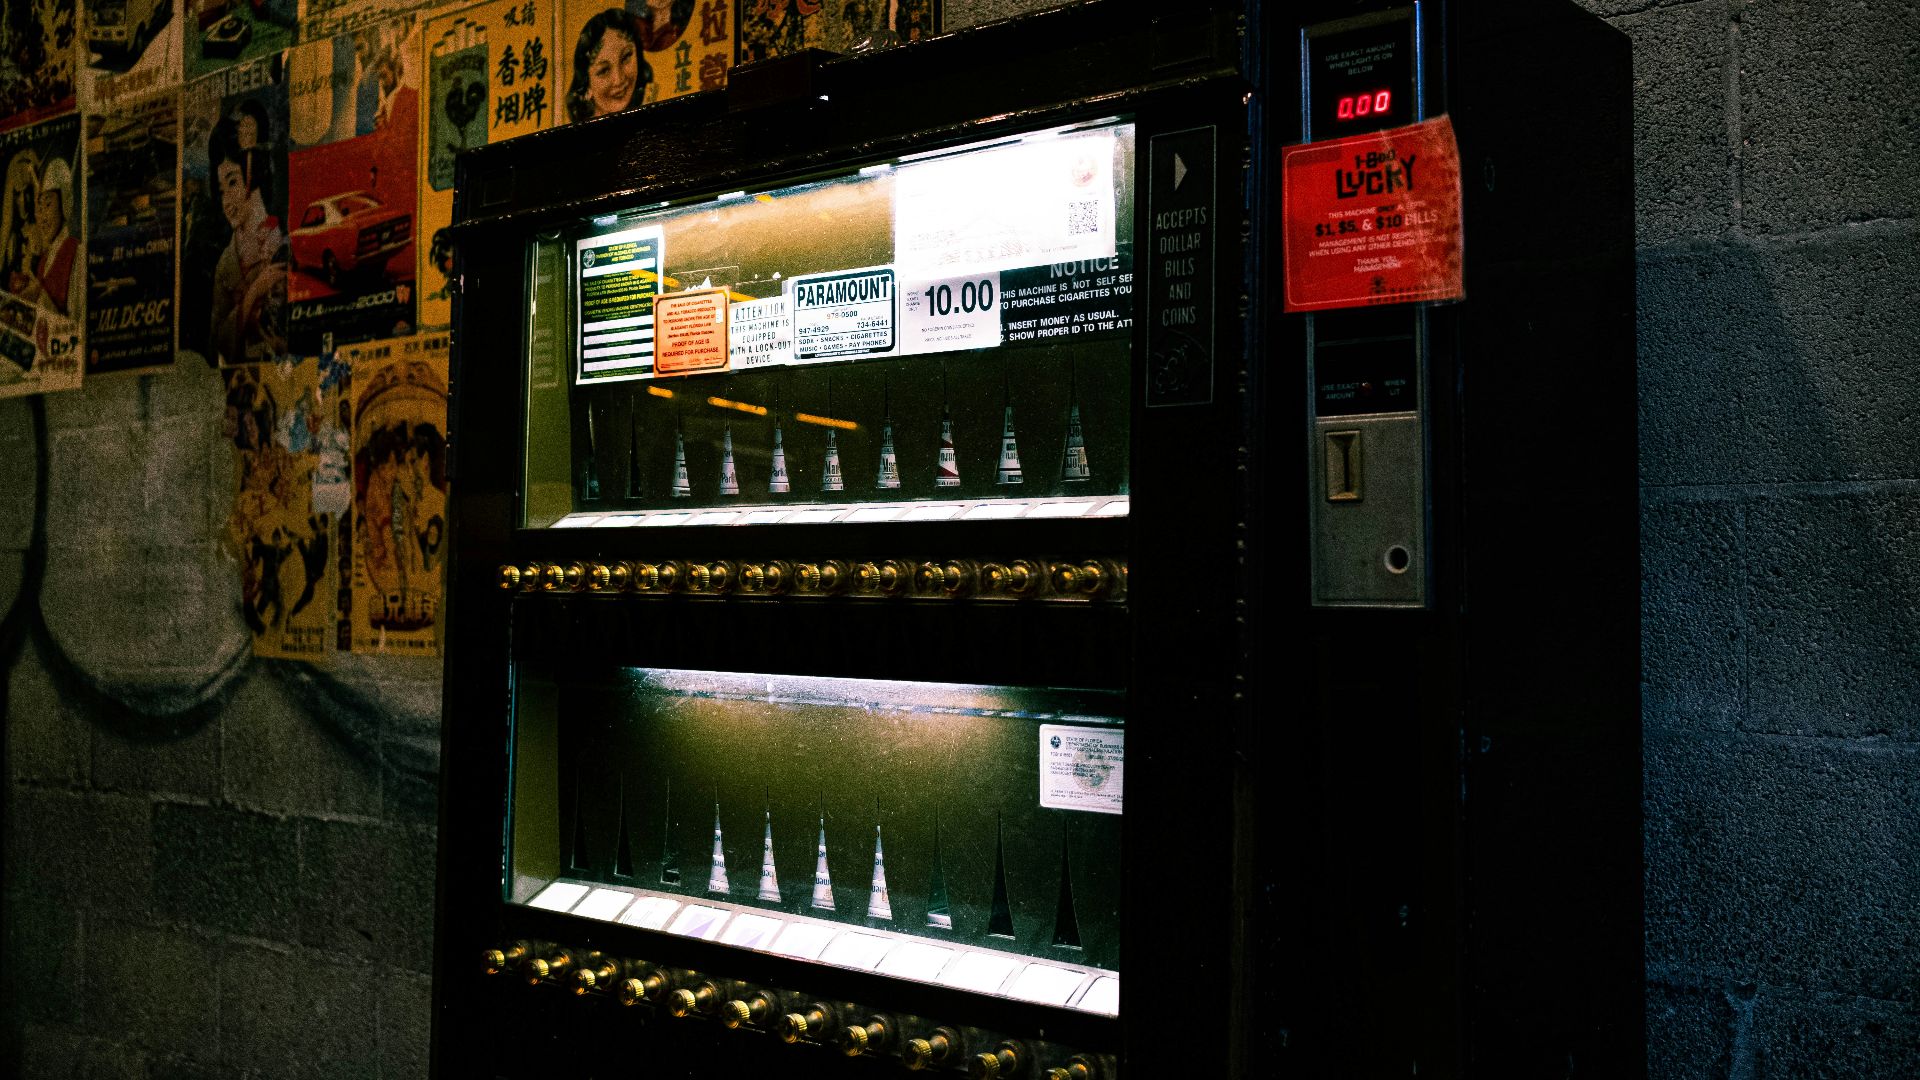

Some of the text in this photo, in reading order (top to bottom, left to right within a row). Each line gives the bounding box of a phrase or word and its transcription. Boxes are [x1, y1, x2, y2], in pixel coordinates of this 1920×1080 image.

[1325, 41, 1396, 62] USE EXACT AMOUNT
[1329, 61, 1350, 70] WHEN
[1348, 65, 1373, 75] BELOW
[1335, 154, 1416, 199] LUCKY
[1155, 206, 1207, 231] ACCEPTS
[1328, 211, 1344, 220] THIS
[1343, 207, 1376, 217] MACHINE
[1361, 218, 1373, 231] &
[1375, 214, 1401, 229] $10
[1404, 210, 1438, 226] BILLS
[1160, 232, 1201, 254] DOLLAR
[1308, 248, 1330, 257] WHEN
[1330, 246, 1351, 255] USING
[1352, 244, 1366, 252] ANY
[1367, 241, 1390, 251] OTHER
[1319, 236, 1366, 248] MANAGEMENT
[1375, 233, 1390, 242] NOT
[1050, 253, 1119, 279] NOTICE
[1165, 257, 1195, 277] BILLS
[1357, 257, 1379, 265] THANK
[797, 275, 889, 307] PARAMOUNT
[1000, 289, 1016, 300] THIS
[1018, 284, 1057, 297] MACHINE
[1060, 283, 1068, 291] IS
[1072, 279, 1090, 290] NOT
[1096, 275, 1117, 286] SELF
[1011, 295, 1056, 309] PURCHASE
[1058, 288, 1110, 302] CIGARETTES
[1114, 285, 1132, 295] YOU
[1169, 282, 1191, 301] AND
[924, 279, 994, 316] 10.00
[736, 302, 785, 321] ATTENTION
[1008, 319, 1037, 331] INSERT
[1040, 315, 1070, 326] MONEY
[1073, 313, 1085, 322] AS
[1087, 310, 1119, 320] USUAL.
[1162, 305, 1196, 327] COINS
[731, 318, 790, 334] THIS MACHINE IS
[1009, 331, 1035, 341] SHOW
[1037, 326, 1069, 338] PROPER
[1071, 325, 1080, 333] ID
[1083, 324, 1094, 332] TO
[1097, 321, 1114, 331] THE
[742, 331, 776, 343] EQUIPPED
[800, 345, 818, 353] MUSIC
[862, 338, 887, 346] PHONES
[820, 335, 844, 343] SNACKS
[850, 330, 888, 340] CIGARETTES
[662, 350, 683, 358] REQUIRED
[730, 346, 745, 356] WITH
[755, 340, 791, 352] LOCK-OUT
[1325, 392, 1356, 400] AMOUNT
